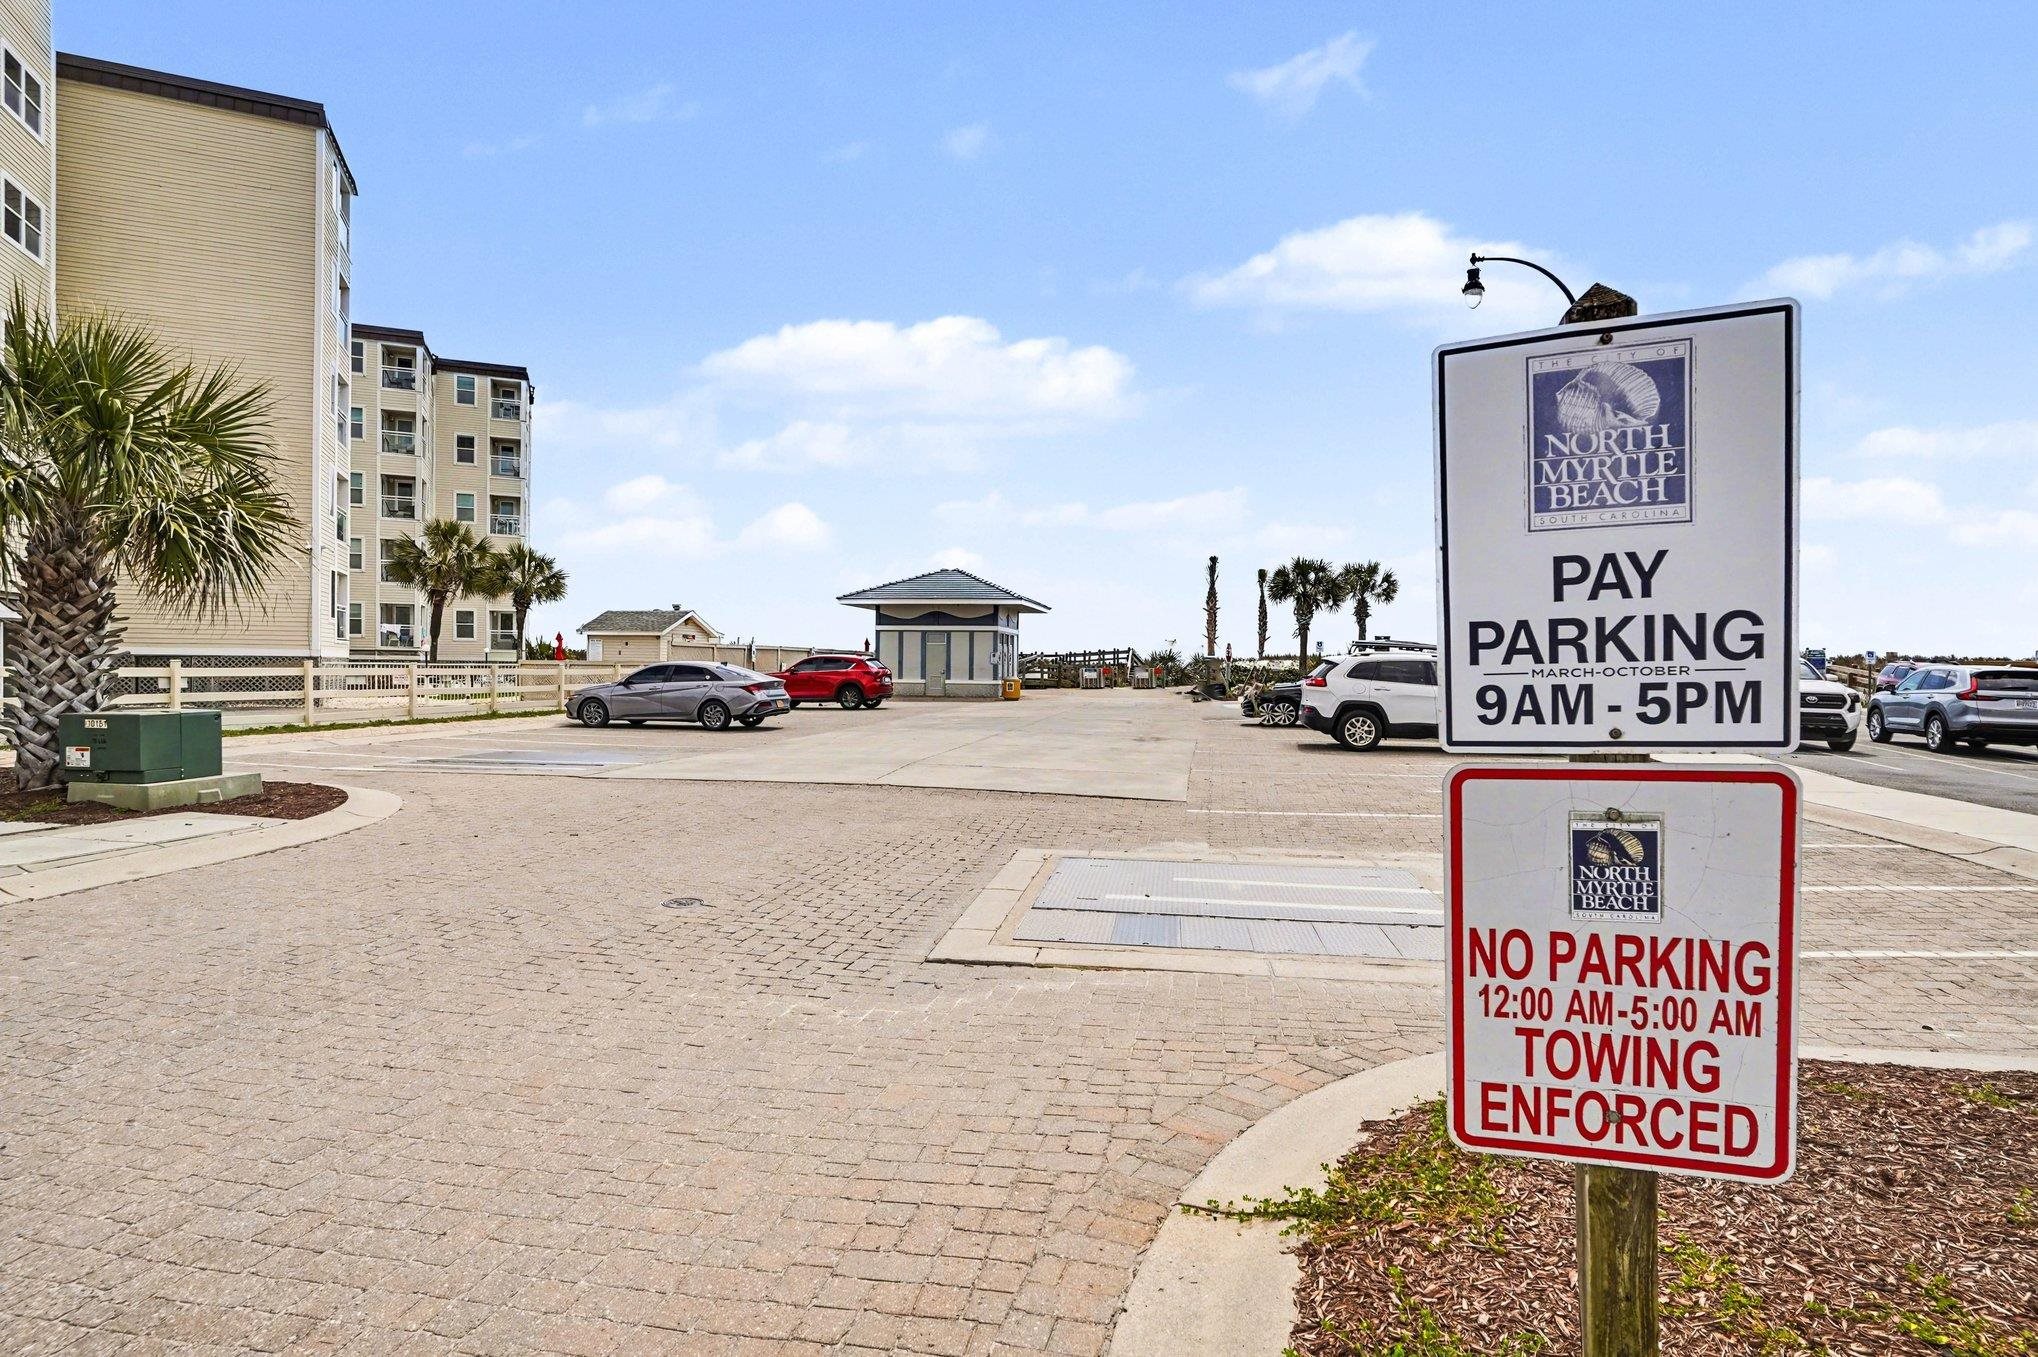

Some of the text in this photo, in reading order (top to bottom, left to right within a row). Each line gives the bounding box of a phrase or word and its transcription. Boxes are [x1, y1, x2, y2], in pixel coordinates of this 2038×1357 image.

[1539, 359, 1572, 369] THE
[1656, 348, 1679, 356] OF
[1544, 423, 1672, 458] NORTH
[1539, 450, 1678, 484] MYRTLE
[1548, 477, 1669, 509] BEACH
[1539, 508, 1681, 525] SOUTH CAROLINA
[1552, 549, 1670, 603] PAY
[1468, 609, 1765, 666] PARKING
[1531, 665, 1691, 679] MARCH-OCTOBER
[1475, 683, 1594, 726] 9AM
[1635, 680, 1762, 725] 5PM
[1576, 880, 1655, 899] MYRTLE
[1579, 865, 1651, 883] NORTH
[1581, 895, 1650, 911] BEACH
[1609, 912, 1656, 920] CAROLNA
[1468, 927, 1772, 996] NO PARKING
[1478, 983, 1552, 1022] 12:00
[1708, 999, 1762, 1038] AM
[1515, 1027, 1721, 1094] TOWING
[1481, 1081, 1759, 1158] ENFORCED
